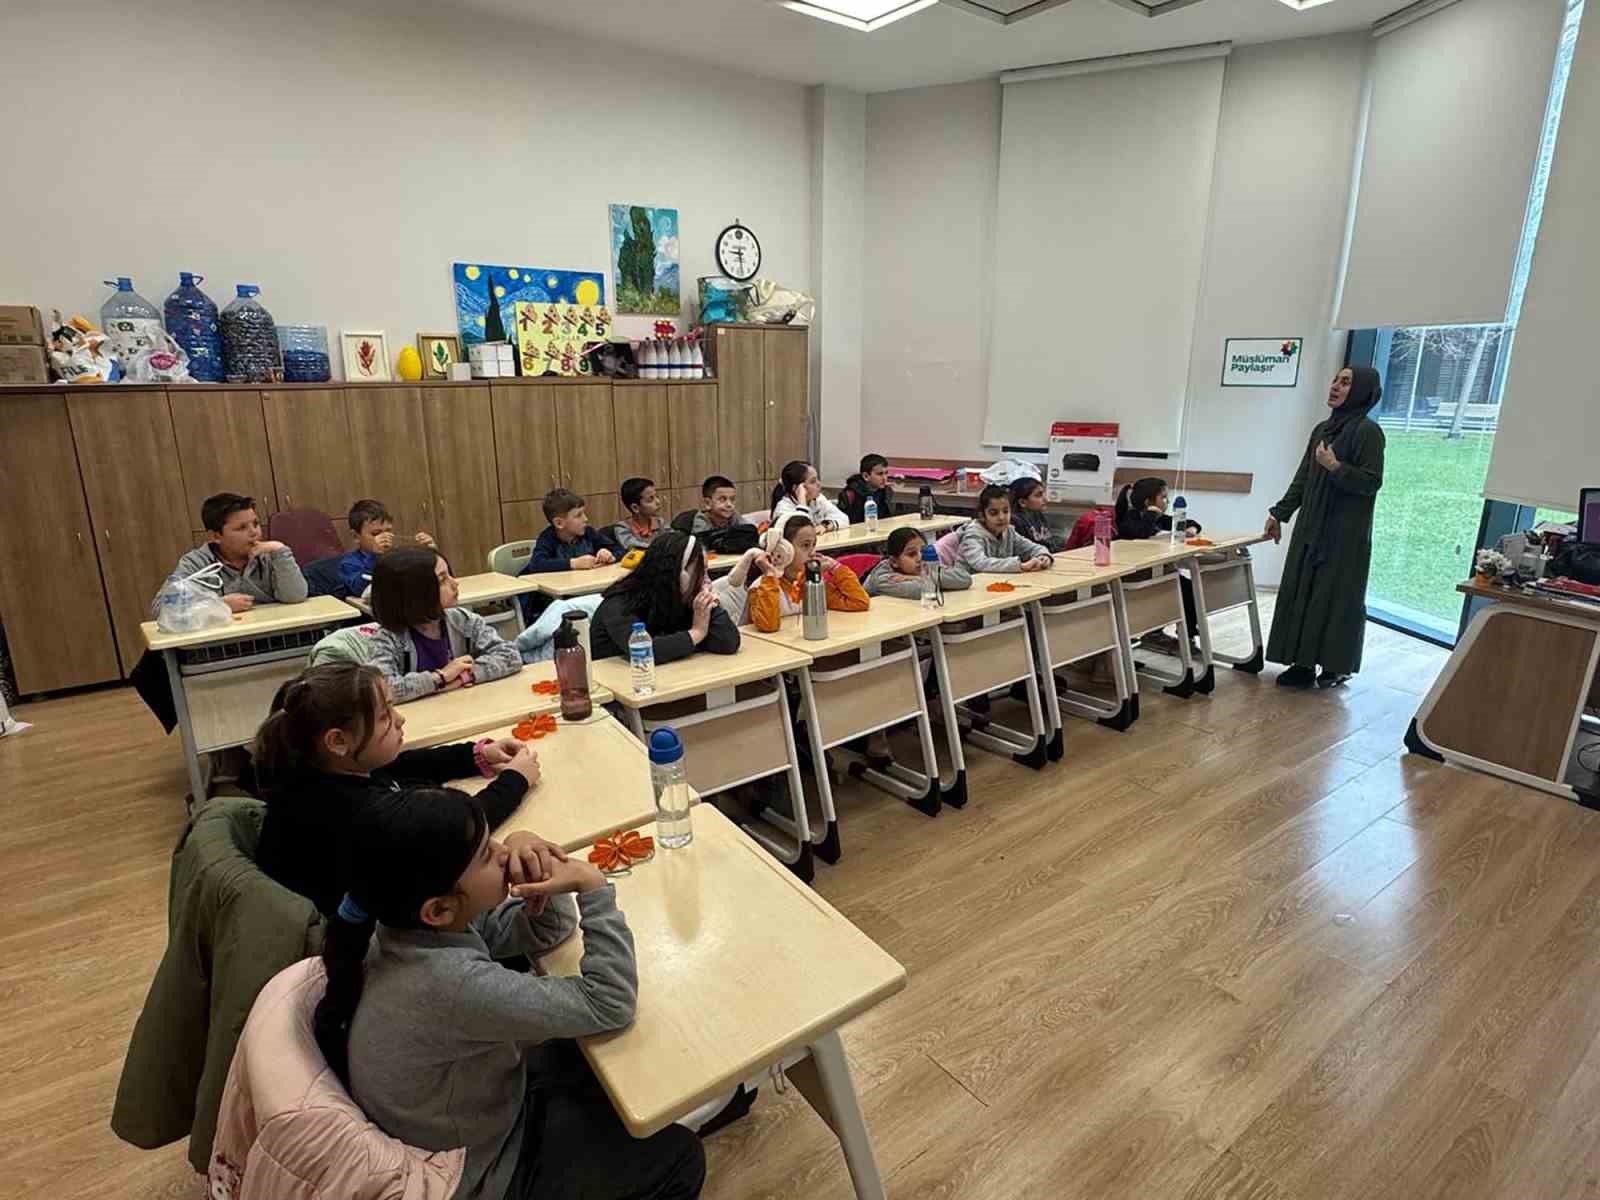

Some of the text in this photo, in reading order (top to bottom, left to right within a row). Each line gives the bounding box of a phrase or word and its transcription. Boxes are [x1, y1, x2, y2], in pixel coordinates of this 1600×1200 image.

[542, 319, 553, 334] 2
[577, 323, 588, 336] 4
[595, 323, 605, 336] 5
[522, 358, 534, 370] 6
[561, 359, 571, 371] 8
[579, 359, 589, 372] 9
[1231, 354, 1290, 363] Müslüman
